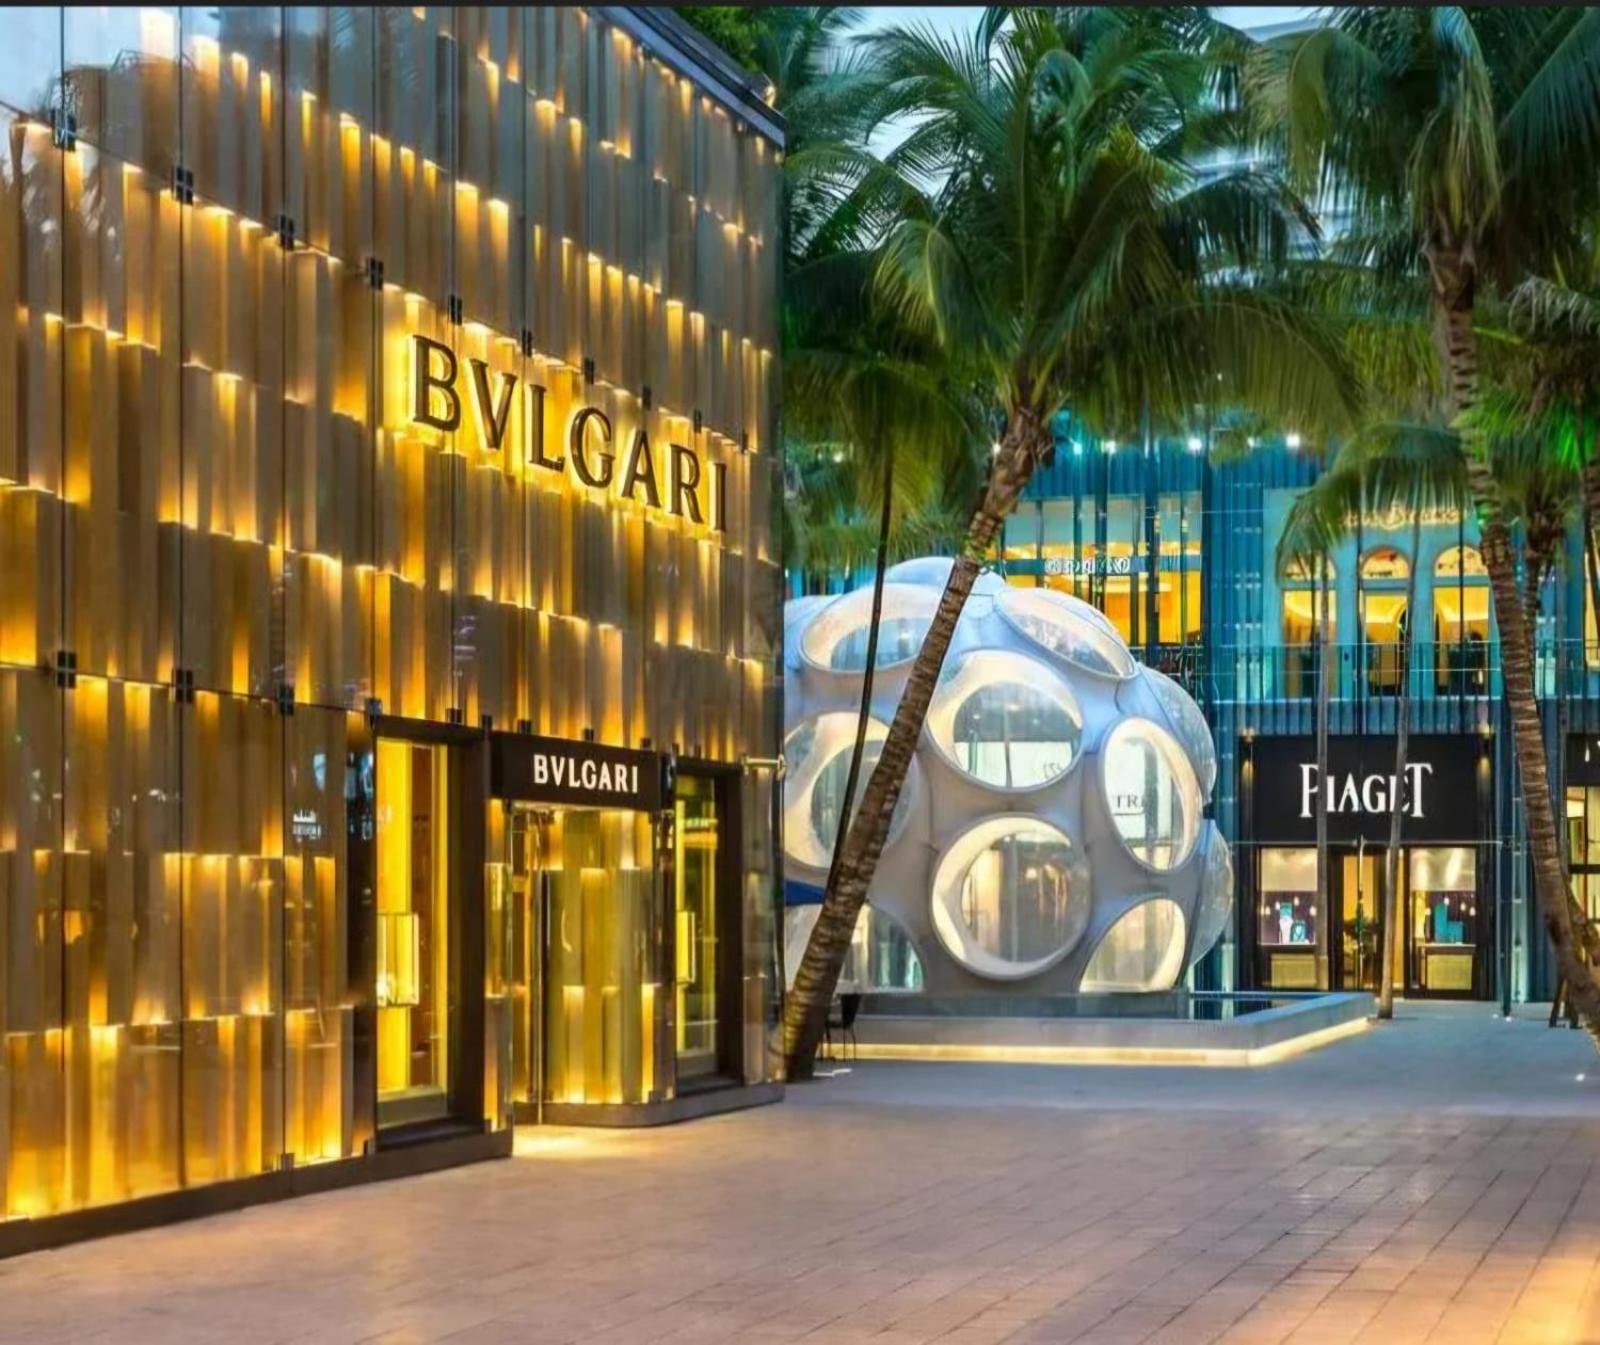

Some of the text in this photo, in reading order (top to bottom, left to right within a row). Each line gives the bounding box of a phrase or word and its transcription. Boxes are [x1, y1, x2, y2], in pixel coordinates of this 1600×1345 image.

[412, 334, 727, 533] BVLGARI
[533, 754, 638, 794] BVLGARI
[1299, 762, 1433, 818] PIAGET
